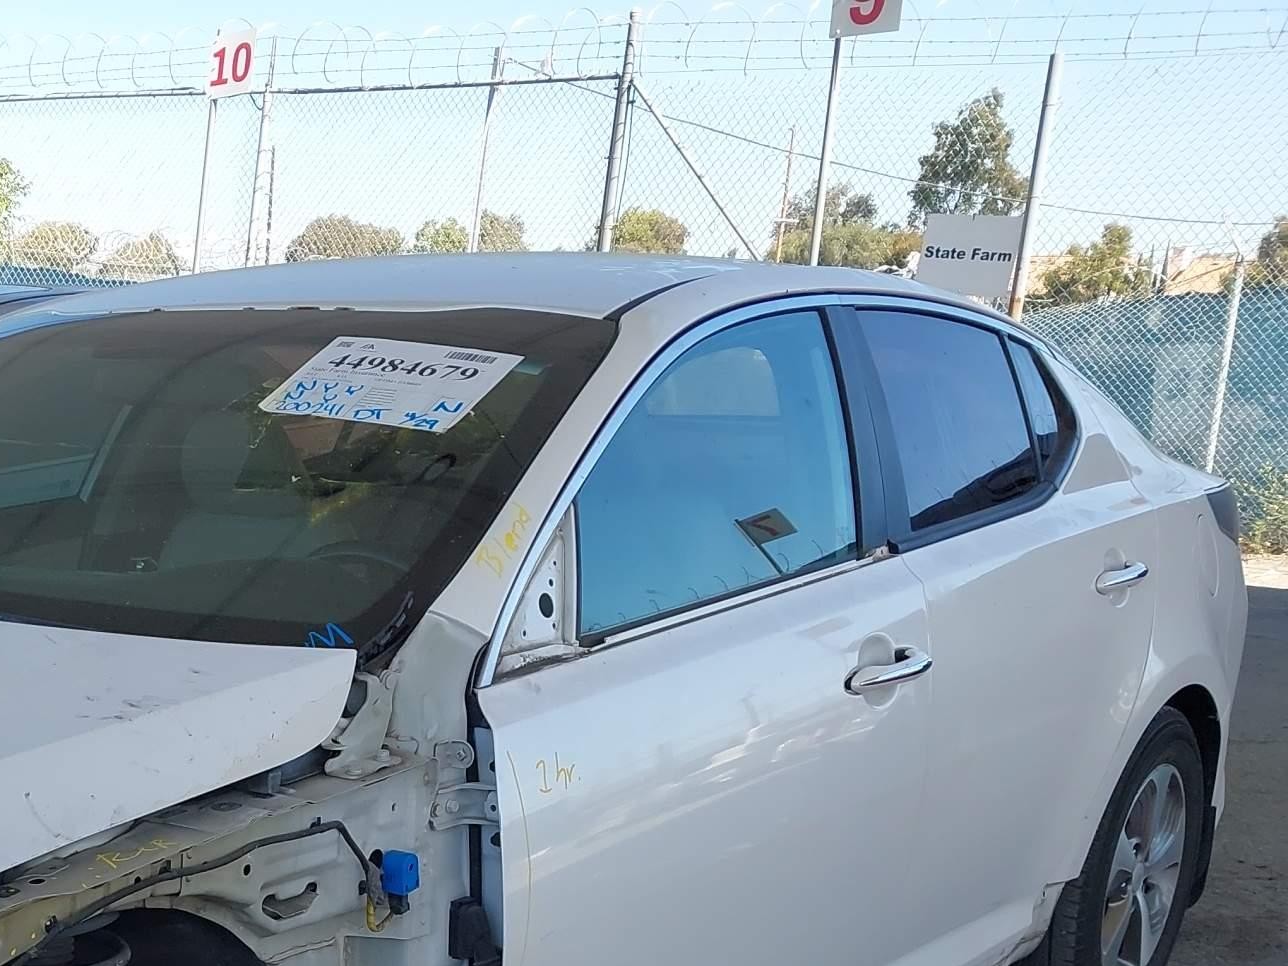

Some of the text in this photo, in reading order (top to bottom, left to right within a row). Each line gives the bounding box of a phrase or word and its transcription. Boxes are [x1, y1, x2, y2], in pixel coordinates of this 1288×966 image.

[210, 42, 252, 87] 10
[924, 245, 1012, 262] State Farm
[327, 353, 480, 381] 44984679
